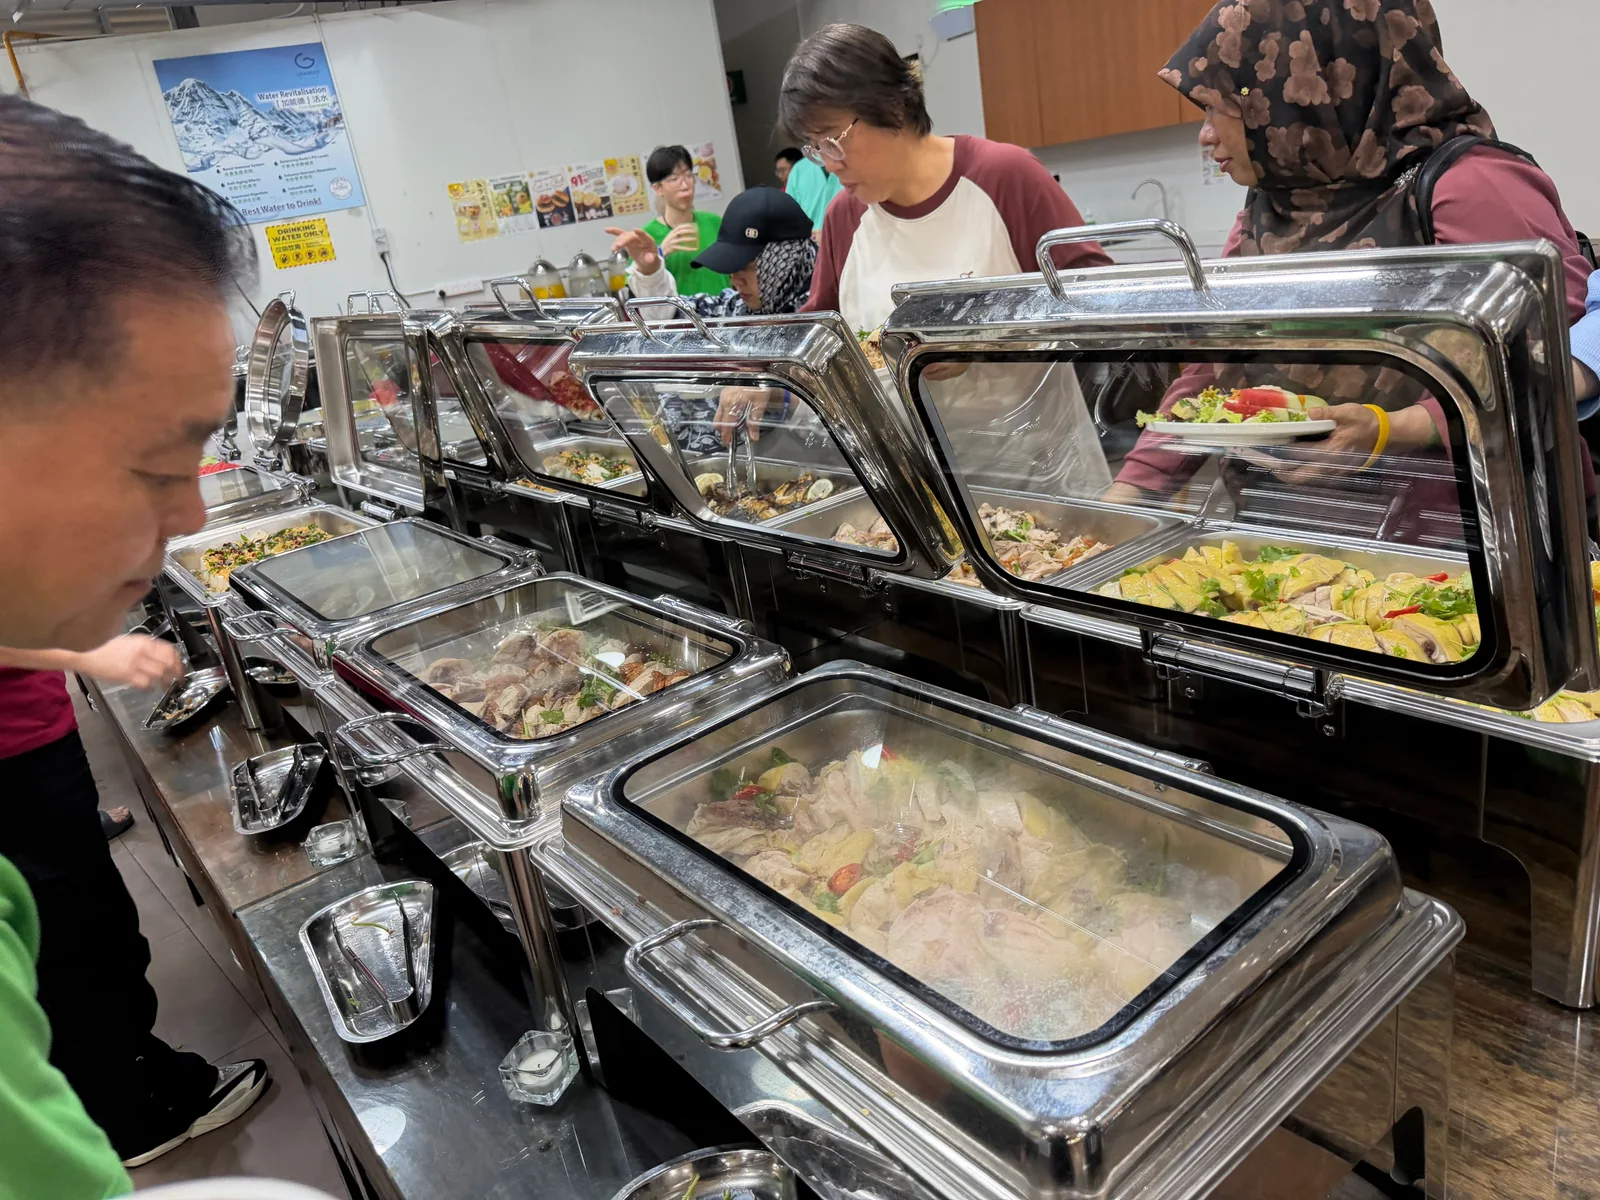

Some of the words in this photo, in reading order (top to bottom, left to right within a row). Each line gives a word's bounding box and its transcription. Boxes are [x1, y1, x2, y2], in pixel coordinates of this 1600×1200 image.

[257, 93, 279, 101] Water
[279, 87, 327, 98] Revitalisation
[241, 206, 260, 215] Best
[260, 203, 285, 213] Water
[286, 201, 296, 209] to
[296, 197, 322, 208] Drink!
[272, 233, 302, 243] WATER
[303, 229, 324, 238] ONLY
[277, 224, 316, 235] DRINKING
